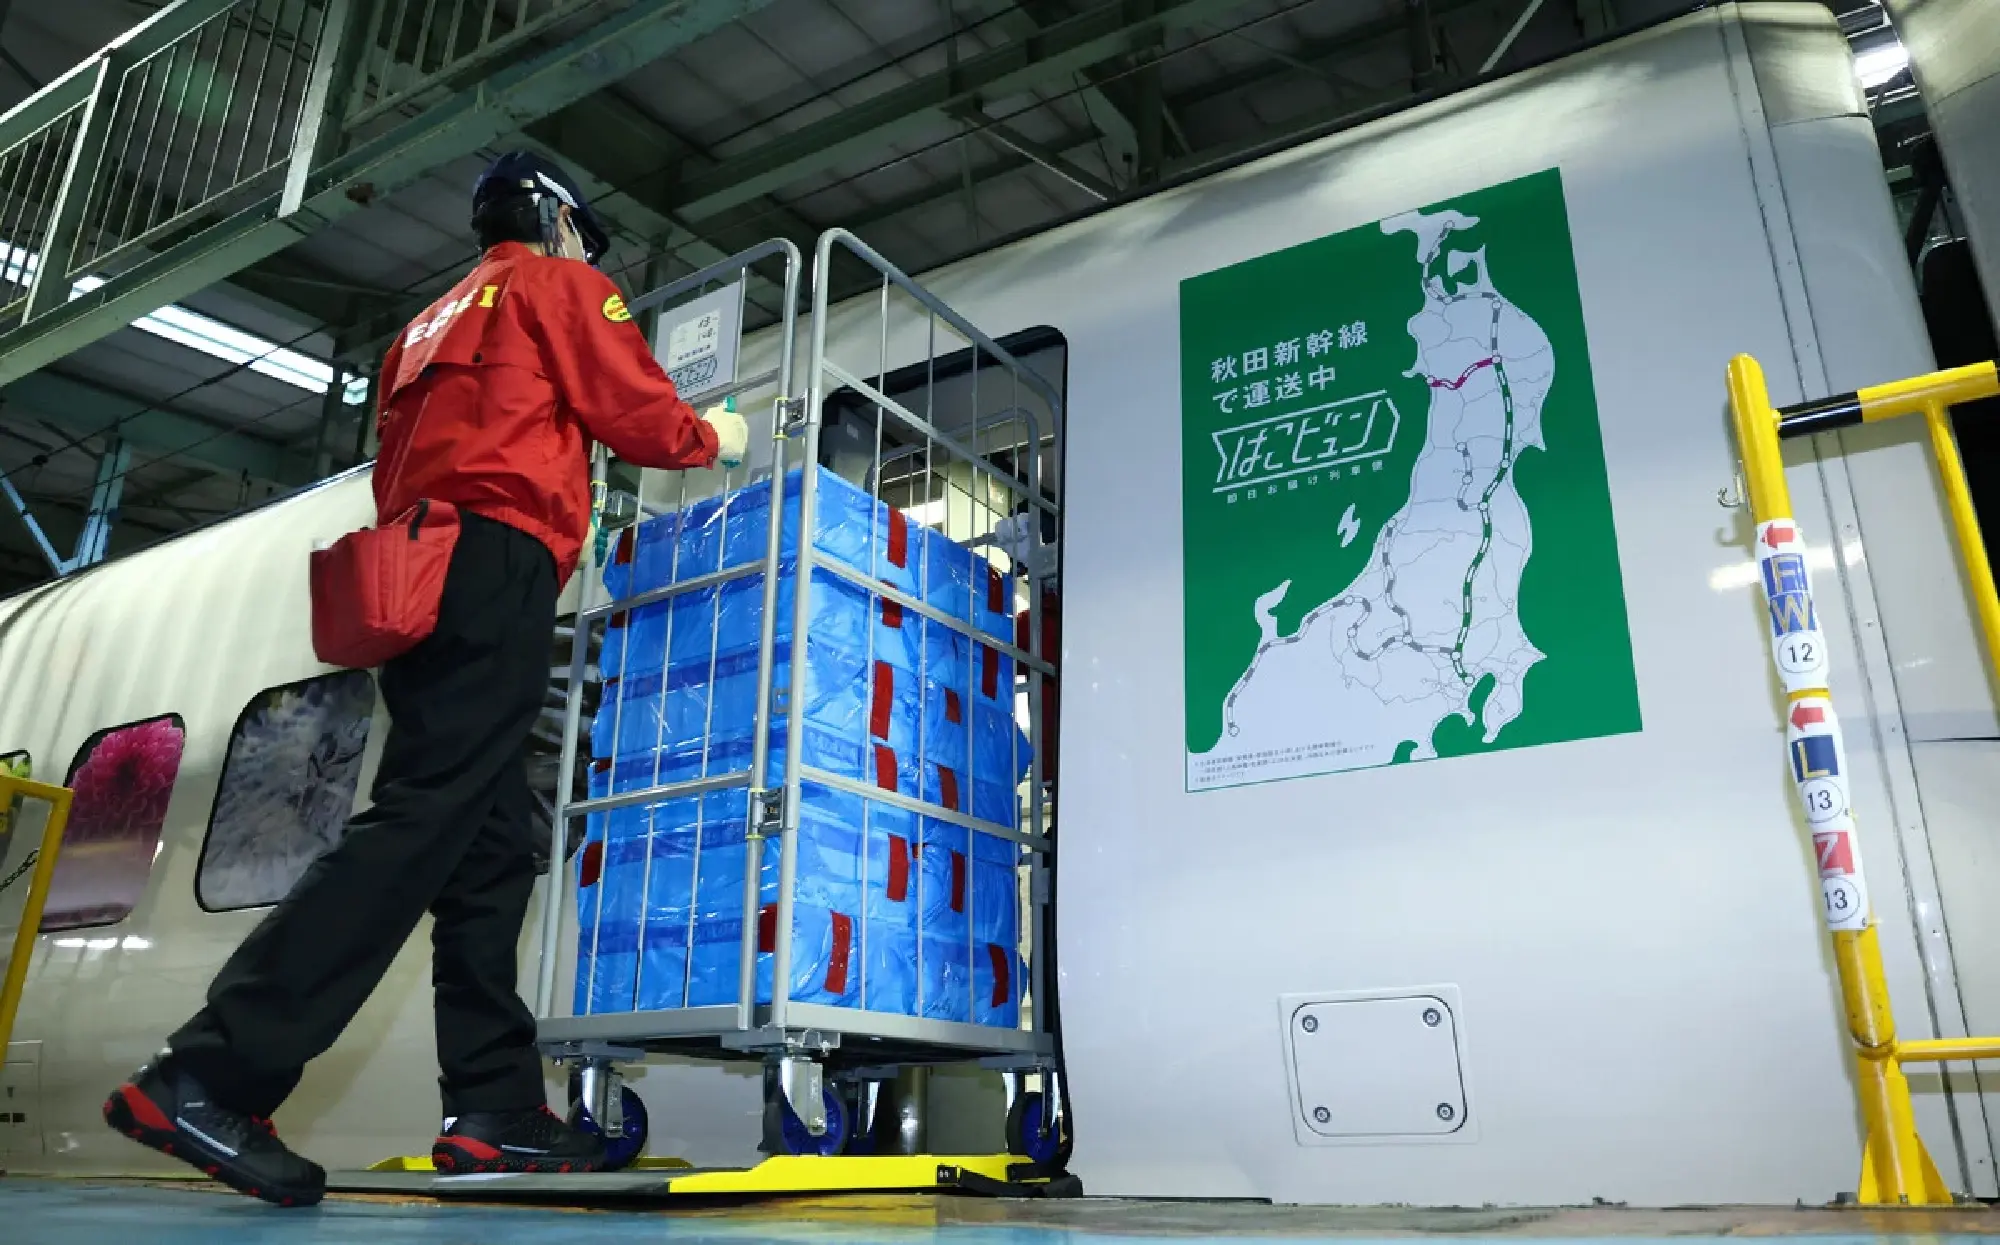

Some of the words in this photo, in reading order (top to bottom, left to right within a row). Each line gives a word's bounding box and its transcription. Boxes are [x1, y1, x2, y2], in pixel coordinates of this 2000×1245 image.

[1211, 320, 1368, 383] 秋田新幹線
[1212, 365, 1336, 414] で運送中
[1227, 399, 1384, 480] はこビュン
[1771, 594, 1810, 633] W
[1787, 642, 1814, 663] 12
[1797, 740, 1830, 779] L
[1807, 789, 1833, 813] 13
[1814, 833, 1846, 877] Z
[1824, 887, 1848, 911] 13
